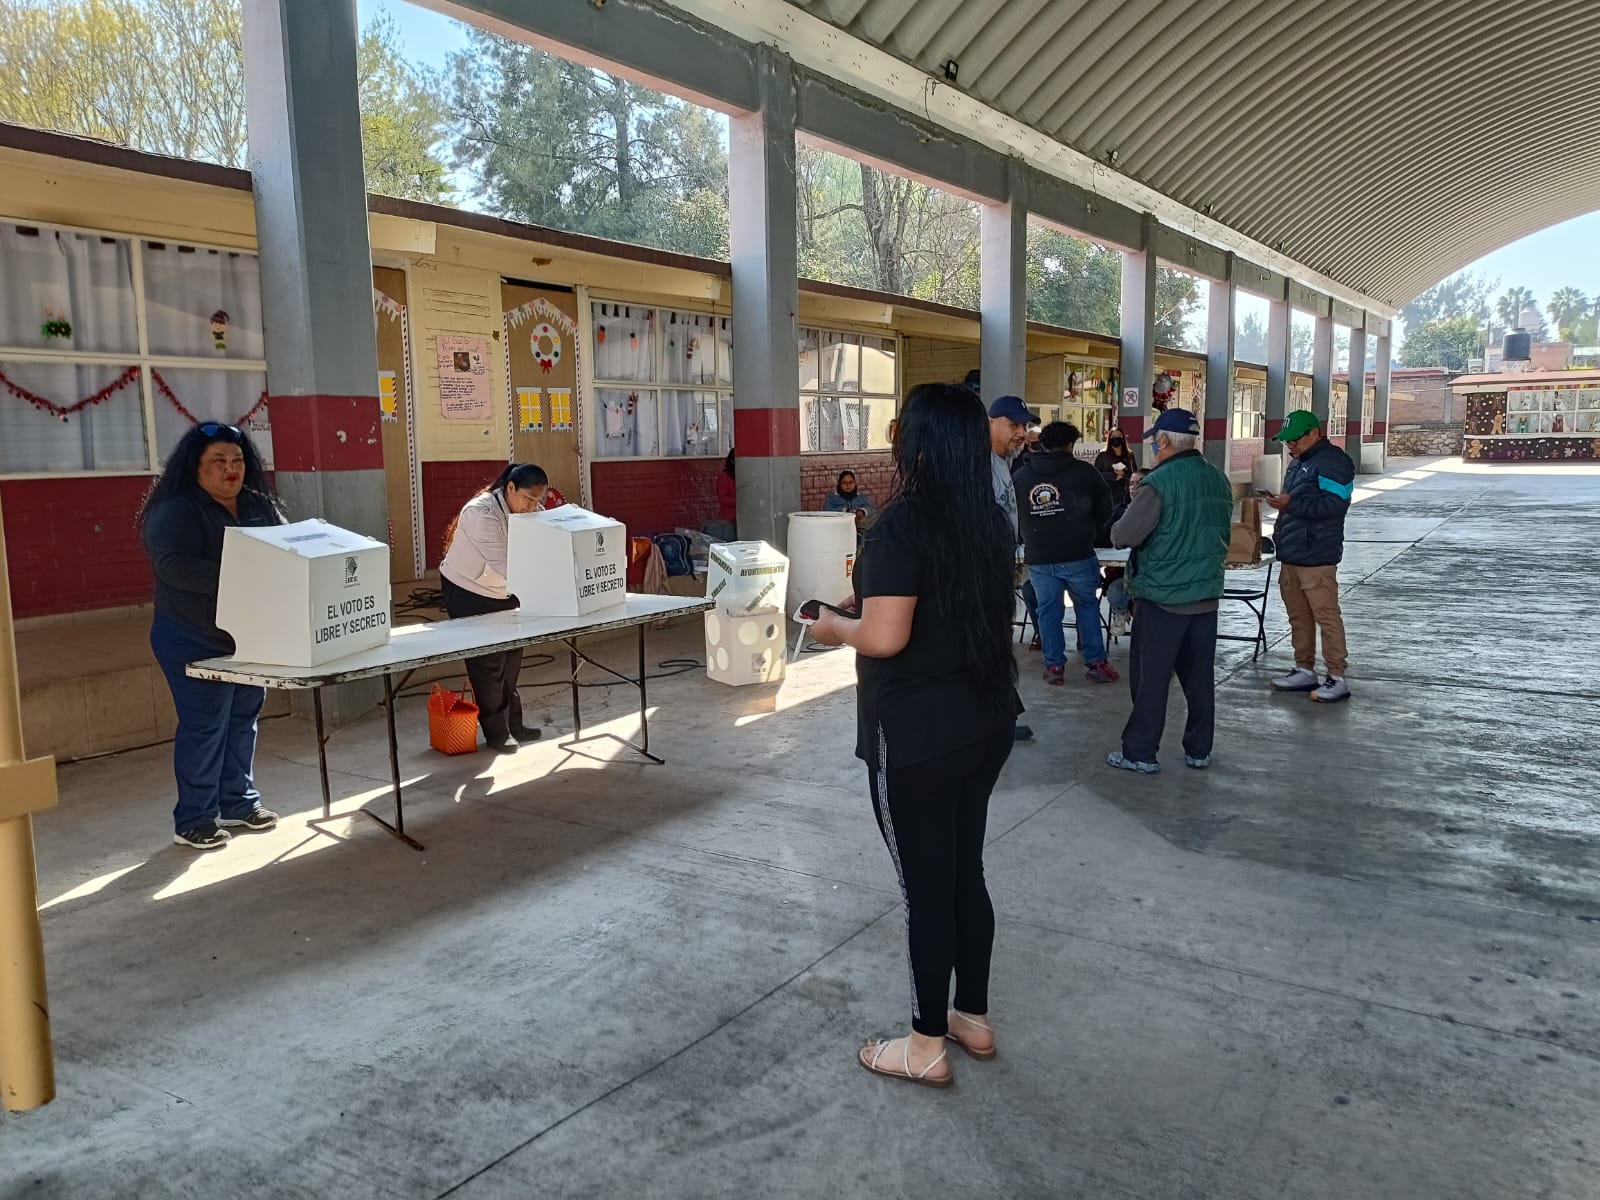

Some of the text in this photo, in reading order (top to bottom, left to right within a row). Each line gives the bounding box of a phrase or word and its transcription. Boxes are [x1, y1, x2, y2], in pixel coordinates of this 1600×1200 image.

[585, 563, 617, 581] EL VOTO ES
[740, 565, 785, 577] AYUNTAMIENTO
[579, 577, 624, 598] LIBRE Y SECRETO
[327, 595, 375, 620] EL VOTO ES
[315, 612, 386, 644] LIBRE Y SECRETO
